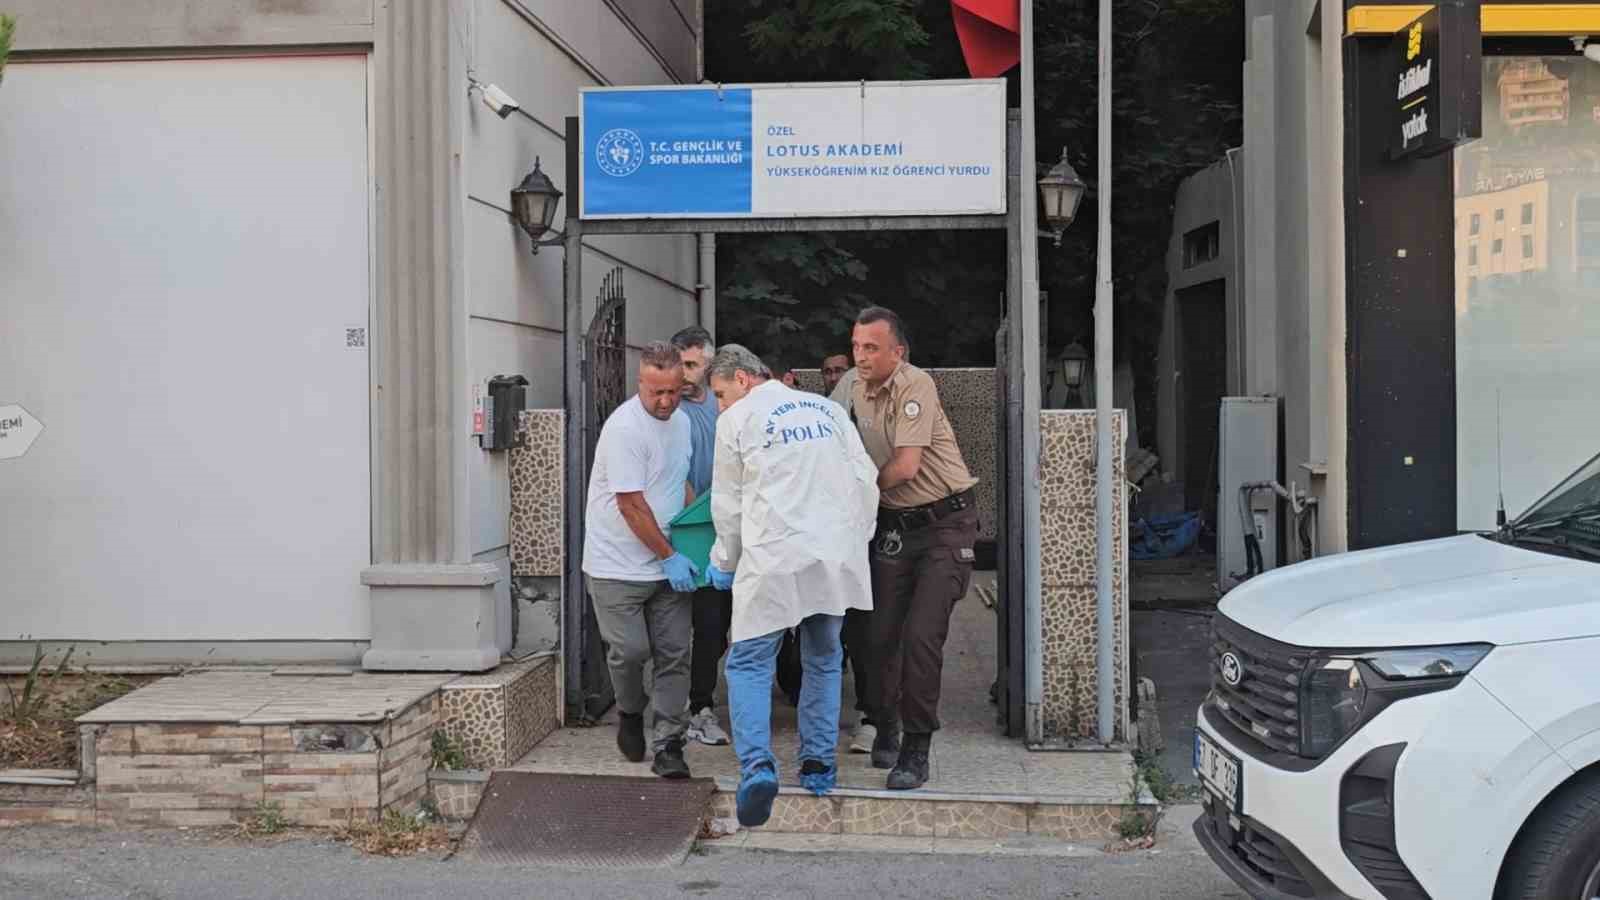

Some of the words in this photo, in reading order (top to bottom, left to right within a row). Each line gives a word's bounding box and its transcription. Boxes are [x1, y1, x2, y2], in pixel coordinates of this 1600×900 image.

[767, 125, 796, 136] ÖZEL
[649, 142, 672, 152] T.C.
[673, 140, 725, 153] GENÇLİK
[727, 141, 743, 151] VE
[767, 144, 820, 157] LOTUS
[826, 141, 903, 157] AKADEMİ
[649, 154, 680, 165] SPOR
[681, 152, 743, 165] BAKANLIĞI
[766, 164, 868, 177] YÜKSEKÖĞRENİM
[870, 166, 890, 176] KIZ
[892, 164, 945, 176] ÖĞRENCİ
[947, 164, 991, 176] YURDU
[0, 415, 23, 430] EMİ
[782, 420, 833, 444] POLİS
